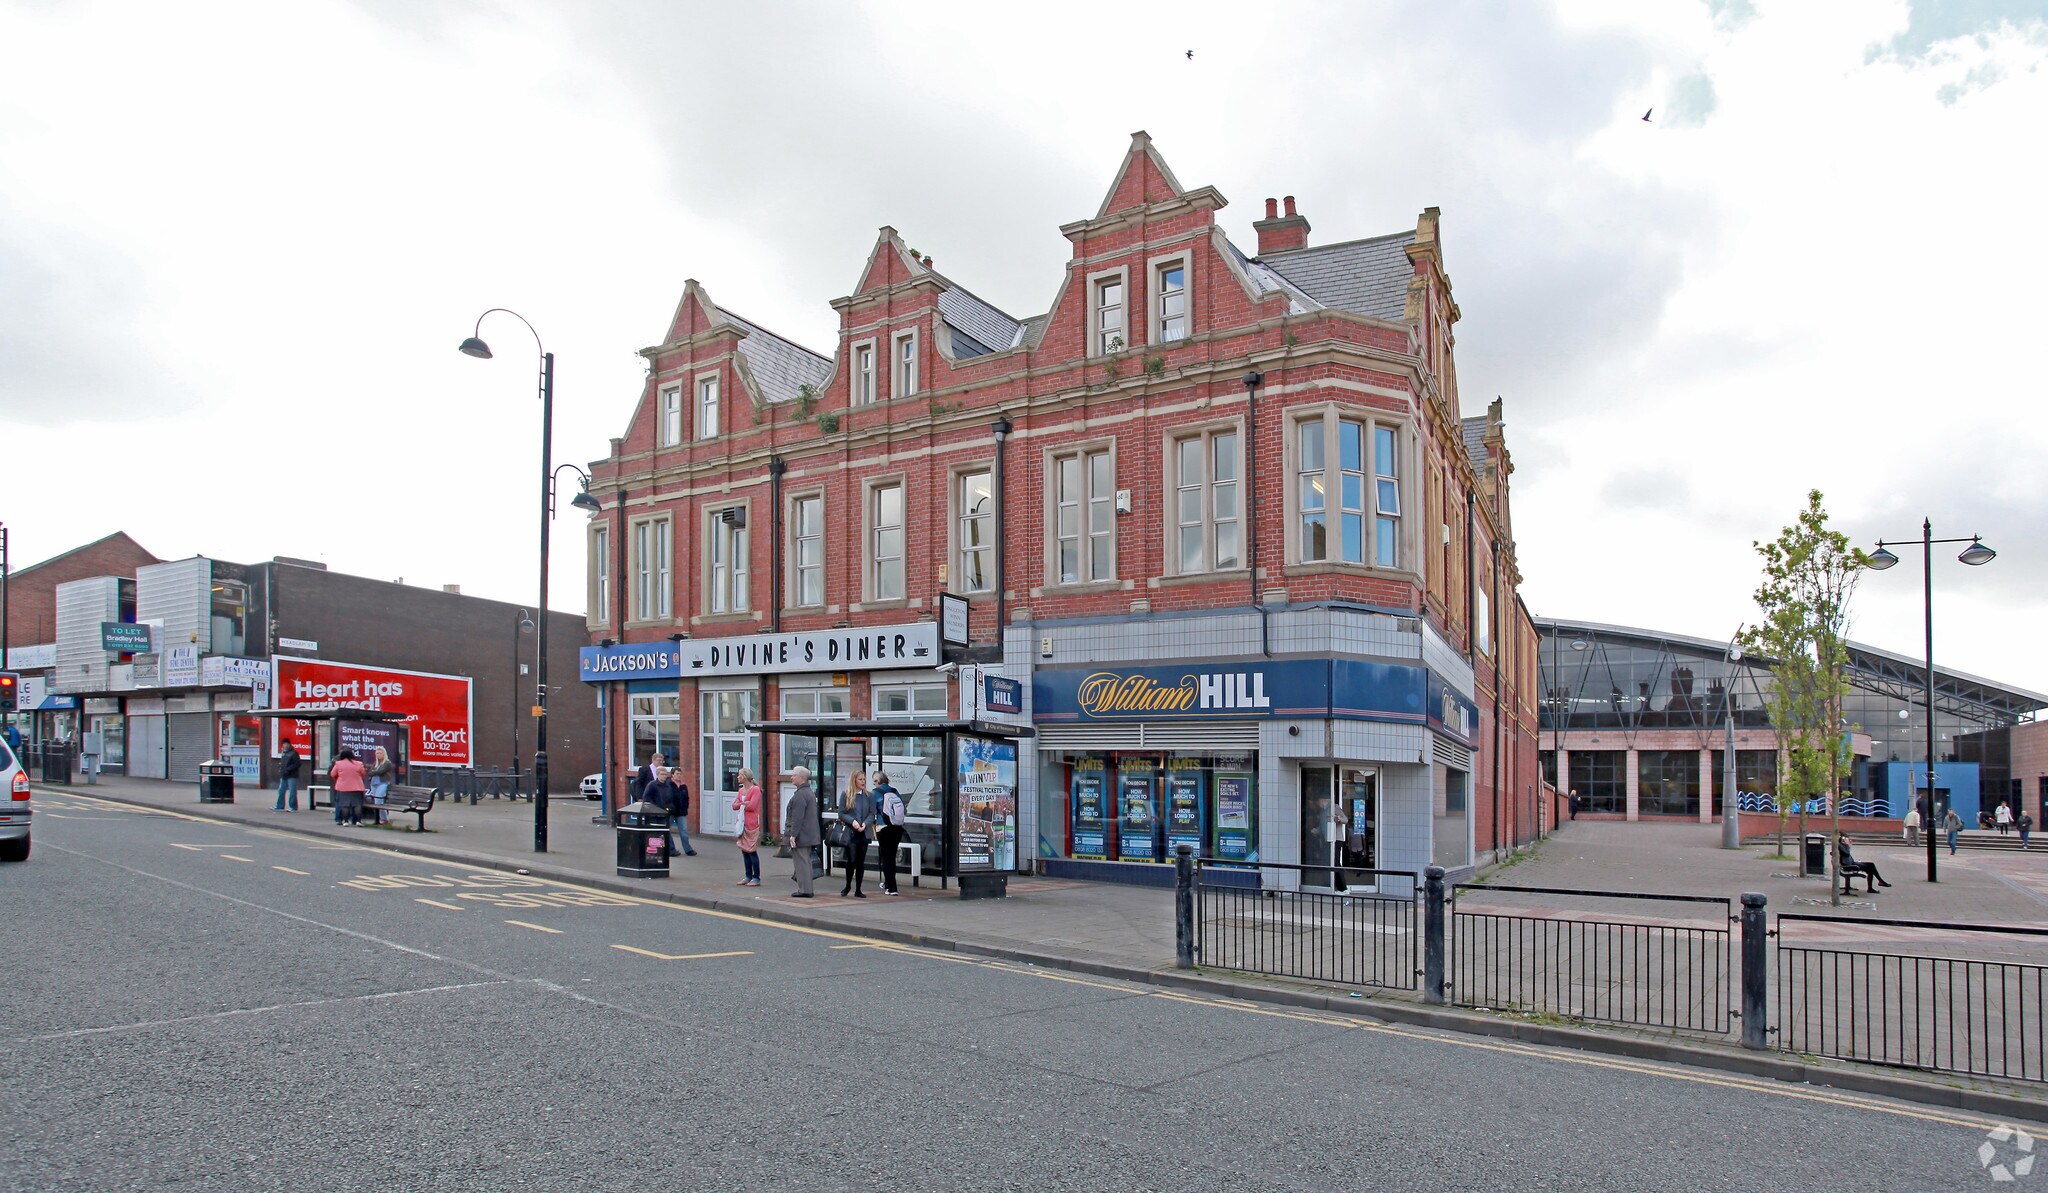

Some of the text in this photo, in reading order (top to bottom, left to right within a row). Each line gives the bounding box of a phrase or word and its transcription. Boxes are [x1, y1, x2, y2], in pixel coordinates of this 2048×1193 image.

[106, 635, 133, 644] Bradley
[711, 634, 906, 667] DIVINE'S DINER
[592, 652, 668, 672] JACKSON'S
[295, 680, 402, 698] Heart has
[1078, 672, 1270, 718] William HILL
[993, 690, 1012, 706] HILL
[342, 726, 390, 737] Smart knows
[423, 725, 466, 744] heart
[1074, 758, 1104, 772] LIMITS
[1121, 759, 1152, 773] LIMITS
[1168, 758, 1200, 773] LIMITS
[968, 772, 997, 784] WIN VIP
[337, 875, 544, 892] STOP
[456, 892, 640, 908] BUS
